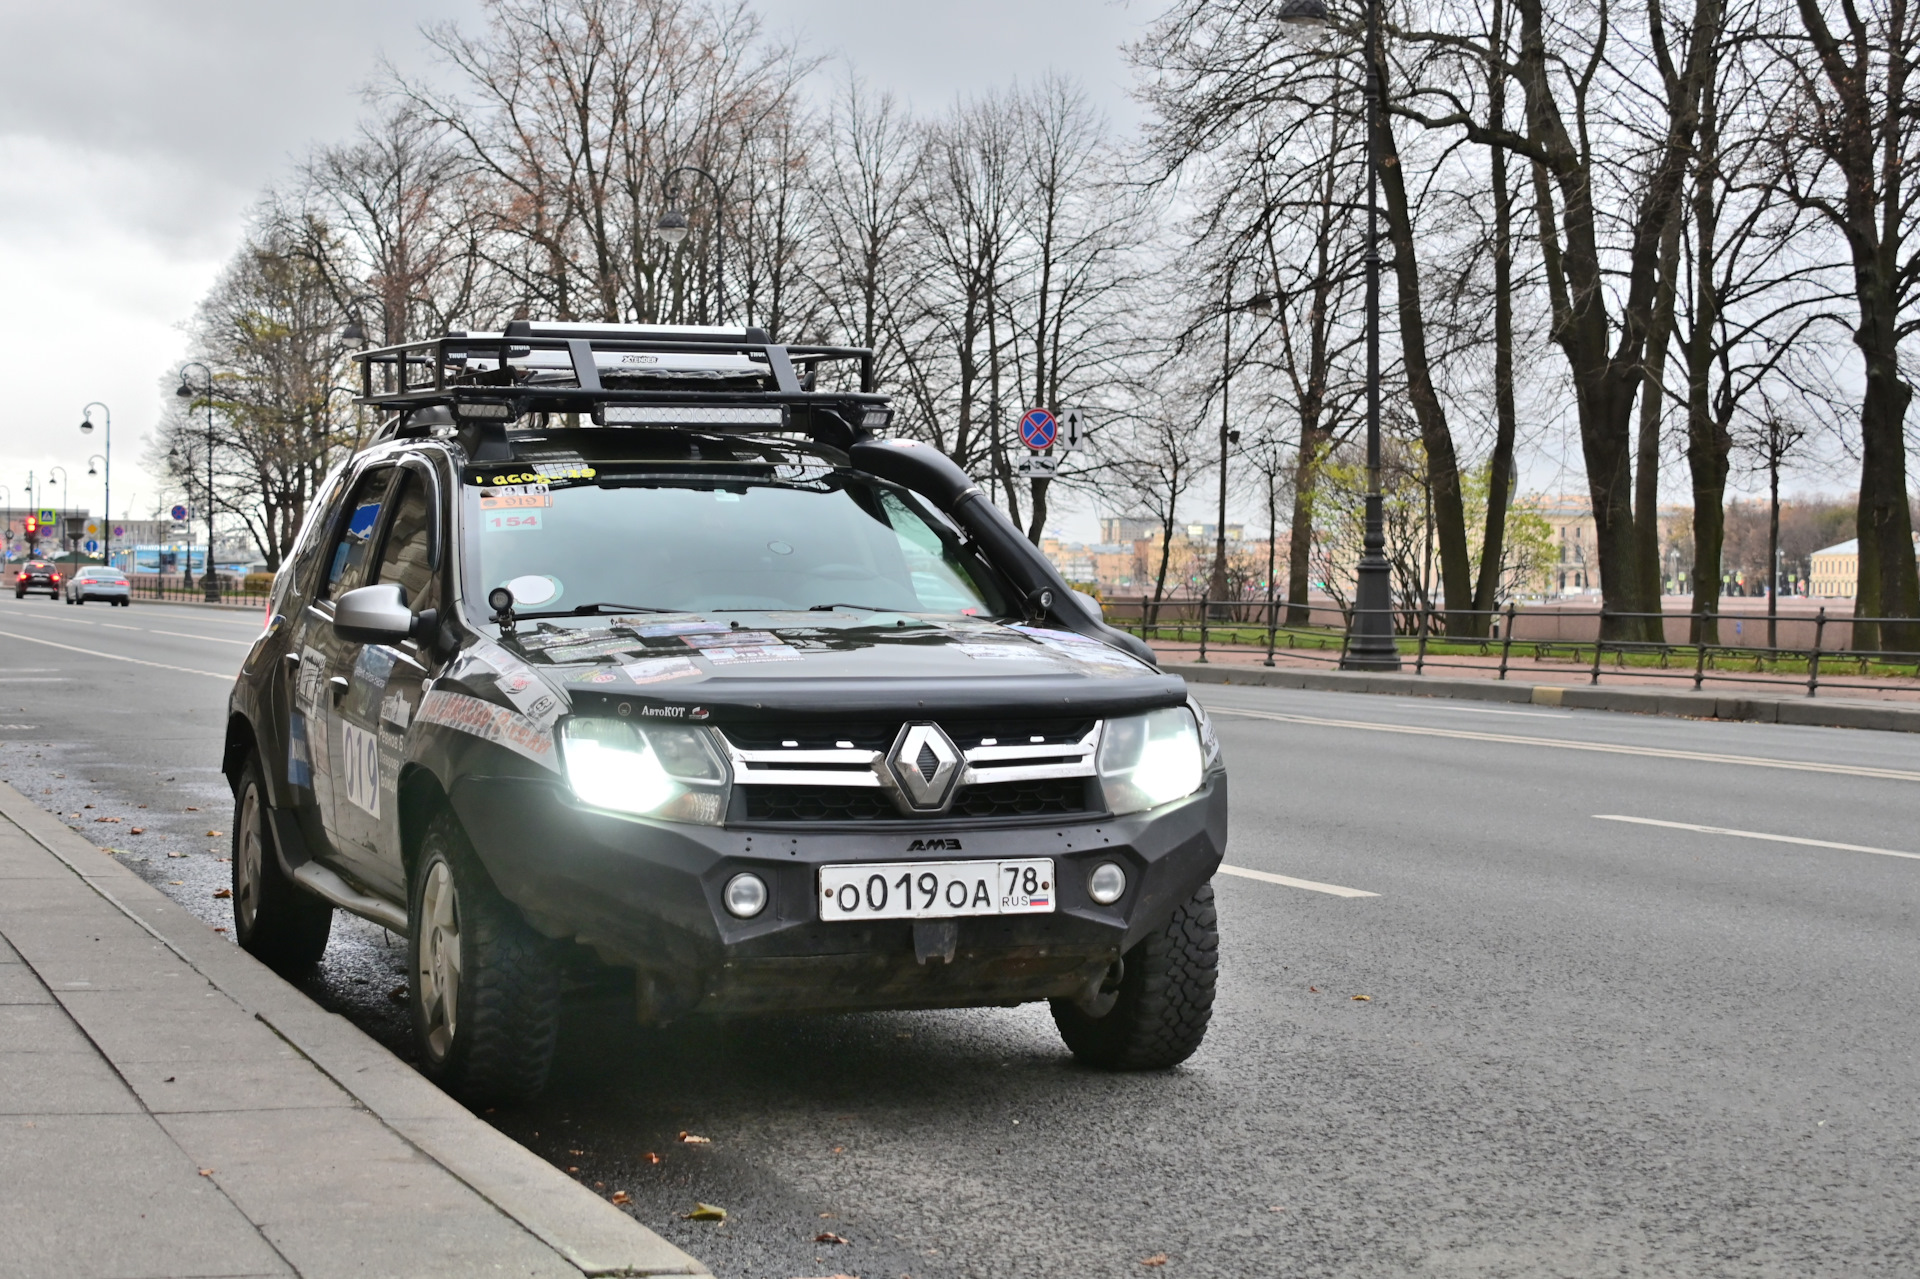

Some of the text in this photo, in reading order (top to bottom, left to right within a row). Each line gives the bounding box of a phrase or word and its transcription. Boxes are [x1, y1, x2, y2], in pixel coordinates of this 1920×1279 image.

[490, 515, 538, 529] 154
[344, 726, 378, 811] 019
[1003, 867, 1039, 896] 78
[1002, 896, 1029, 907] RUS
